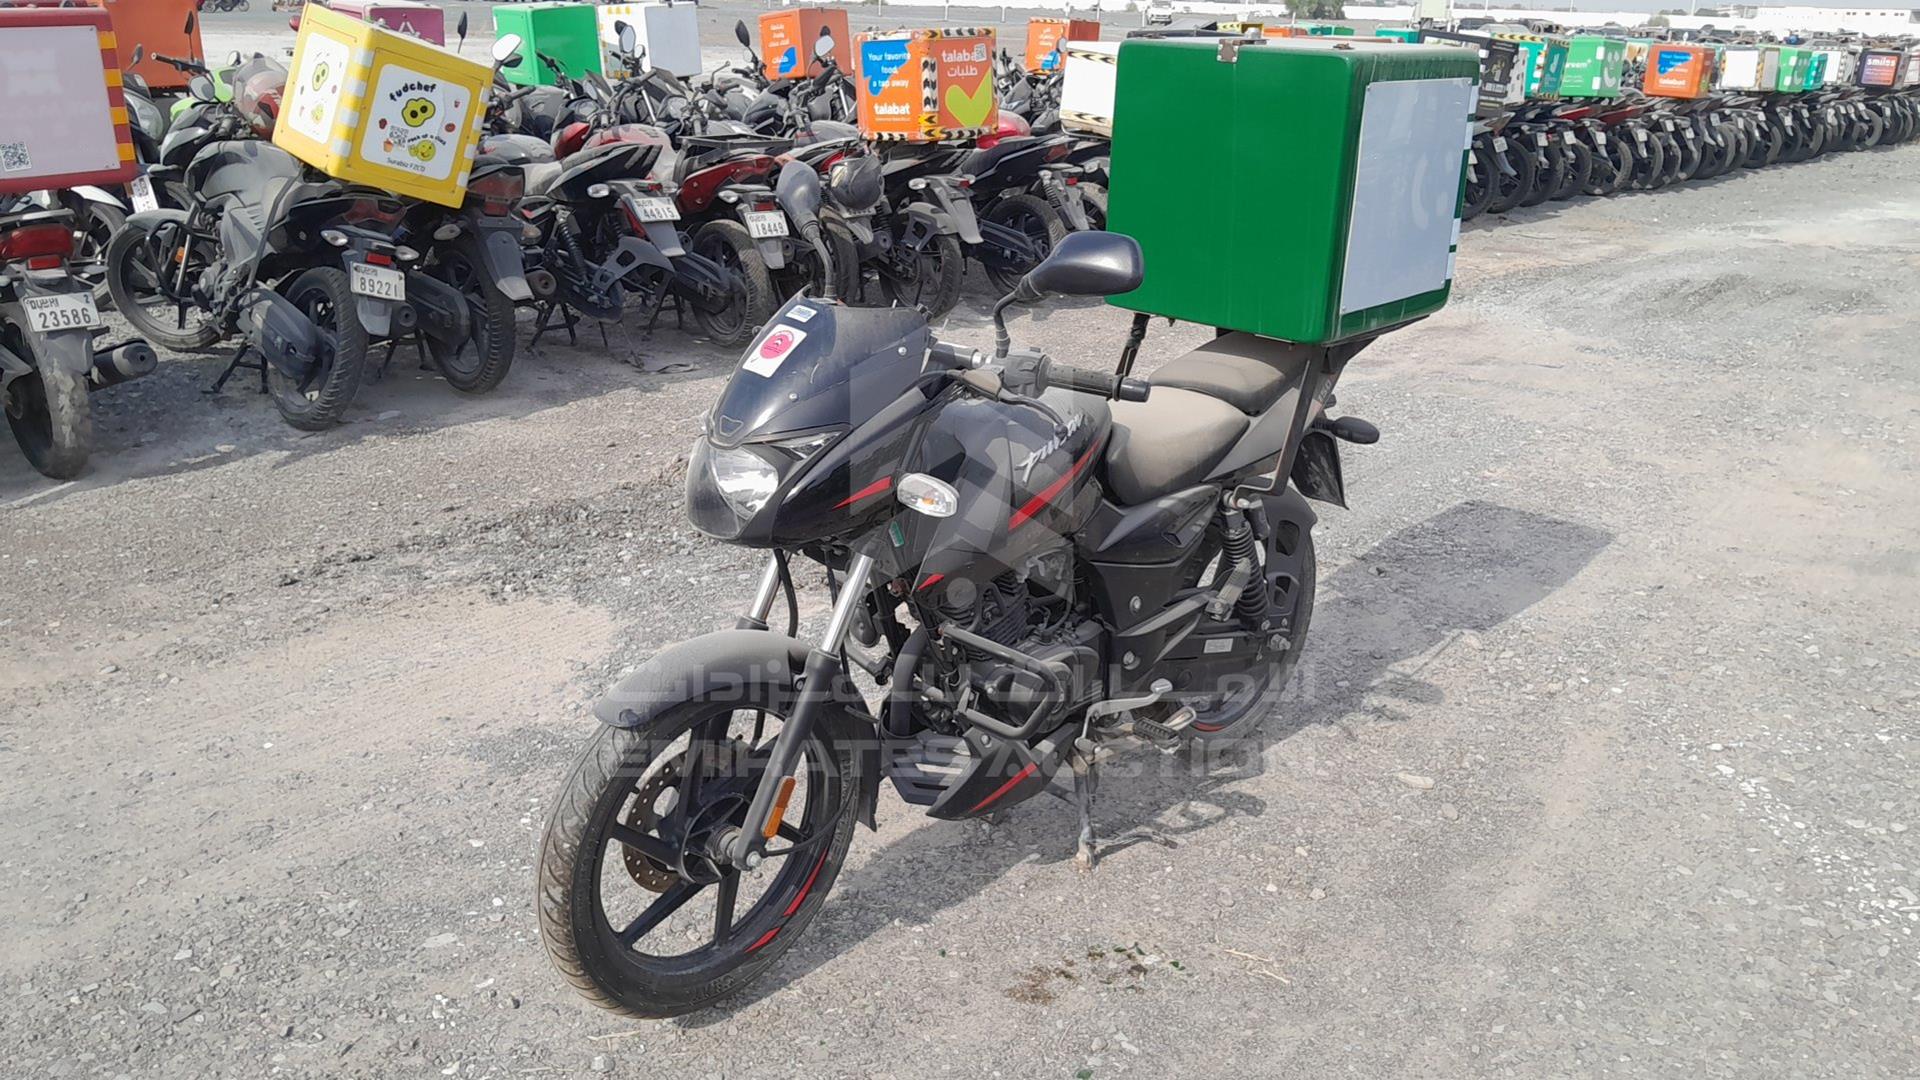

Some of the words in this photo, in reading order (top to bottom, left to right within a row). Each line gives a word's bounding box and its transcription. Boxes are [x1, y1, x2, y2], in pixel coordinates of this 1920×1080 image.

[868, 52, 883, 62] Your
[884, 51, 911, 62] favorite
[942, 47, 981, 63] talaba
[1867, 57, 1896, 67] smiles
[947, 65, 978, 78] طلبات
[878, 80, 890, 89] tap
[892, 80, 909, 89] away
[389, 81, 437, 102] fudchef
[874, 102, 911, 115] talabat
[643, 206, 676, 219] 44815
[755, 221, 785, 236] 18449
[359, 276, 398, 298] 89221
[83, 294, 91, 304] 2
[38, 307, 92, 329] 23586
